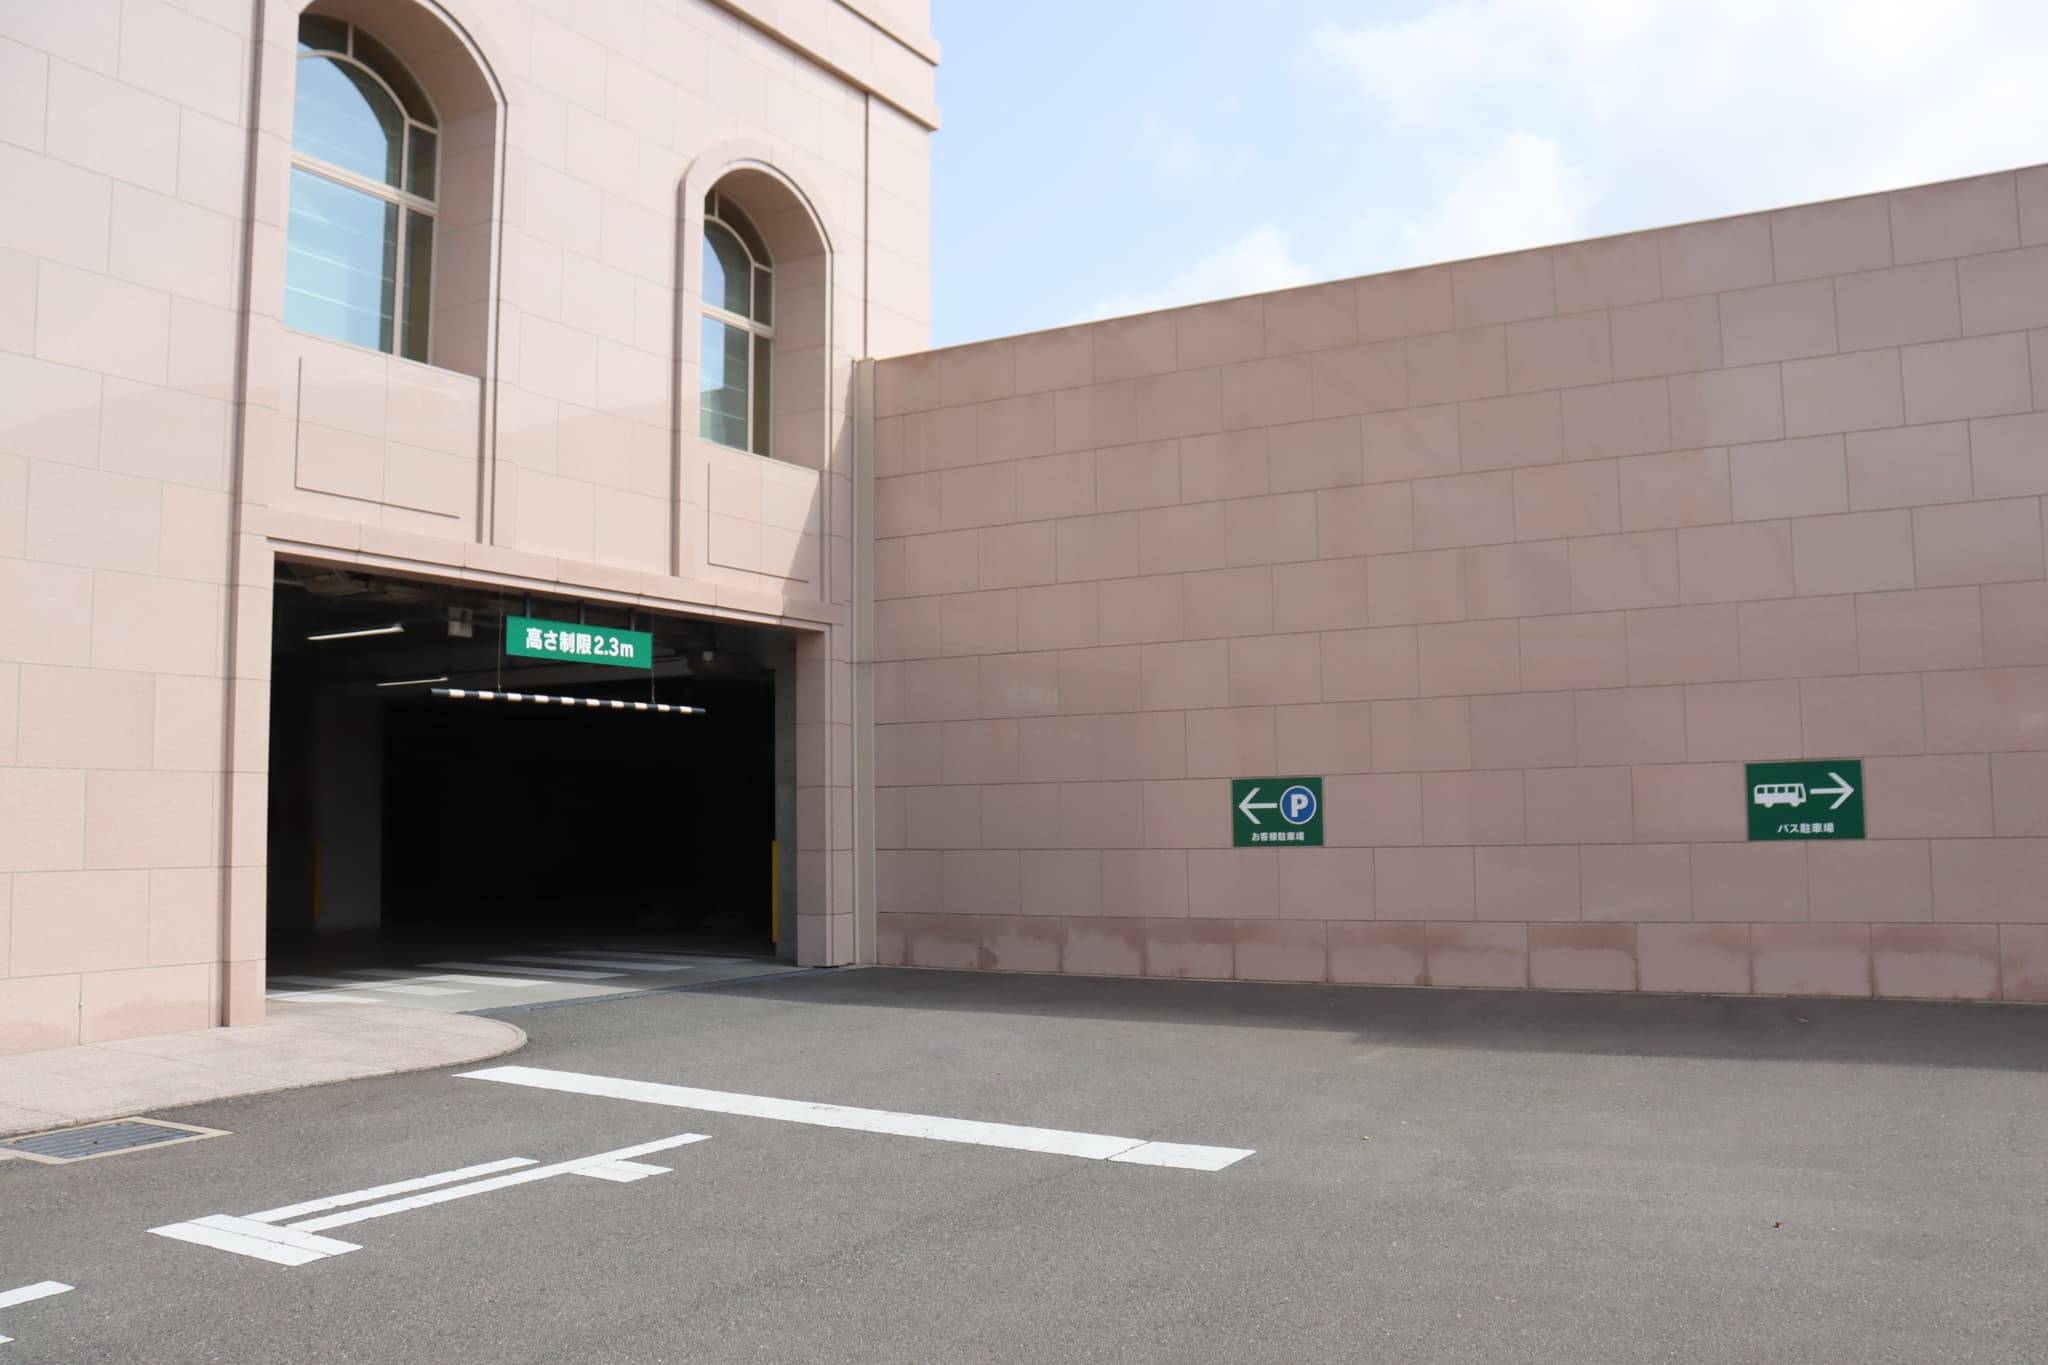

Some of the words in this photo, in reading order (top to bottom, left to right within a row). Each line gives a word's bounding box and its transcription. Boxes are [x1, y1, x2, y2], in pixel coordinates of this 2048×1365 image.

[526, 627, 634, 658] 高さ制限2.3m
[1290, 794, 1309, 818] P
[1251, 831, 1304, 842] お客様駐車場
[1777, 822, 1834, 834] バス駐車場
